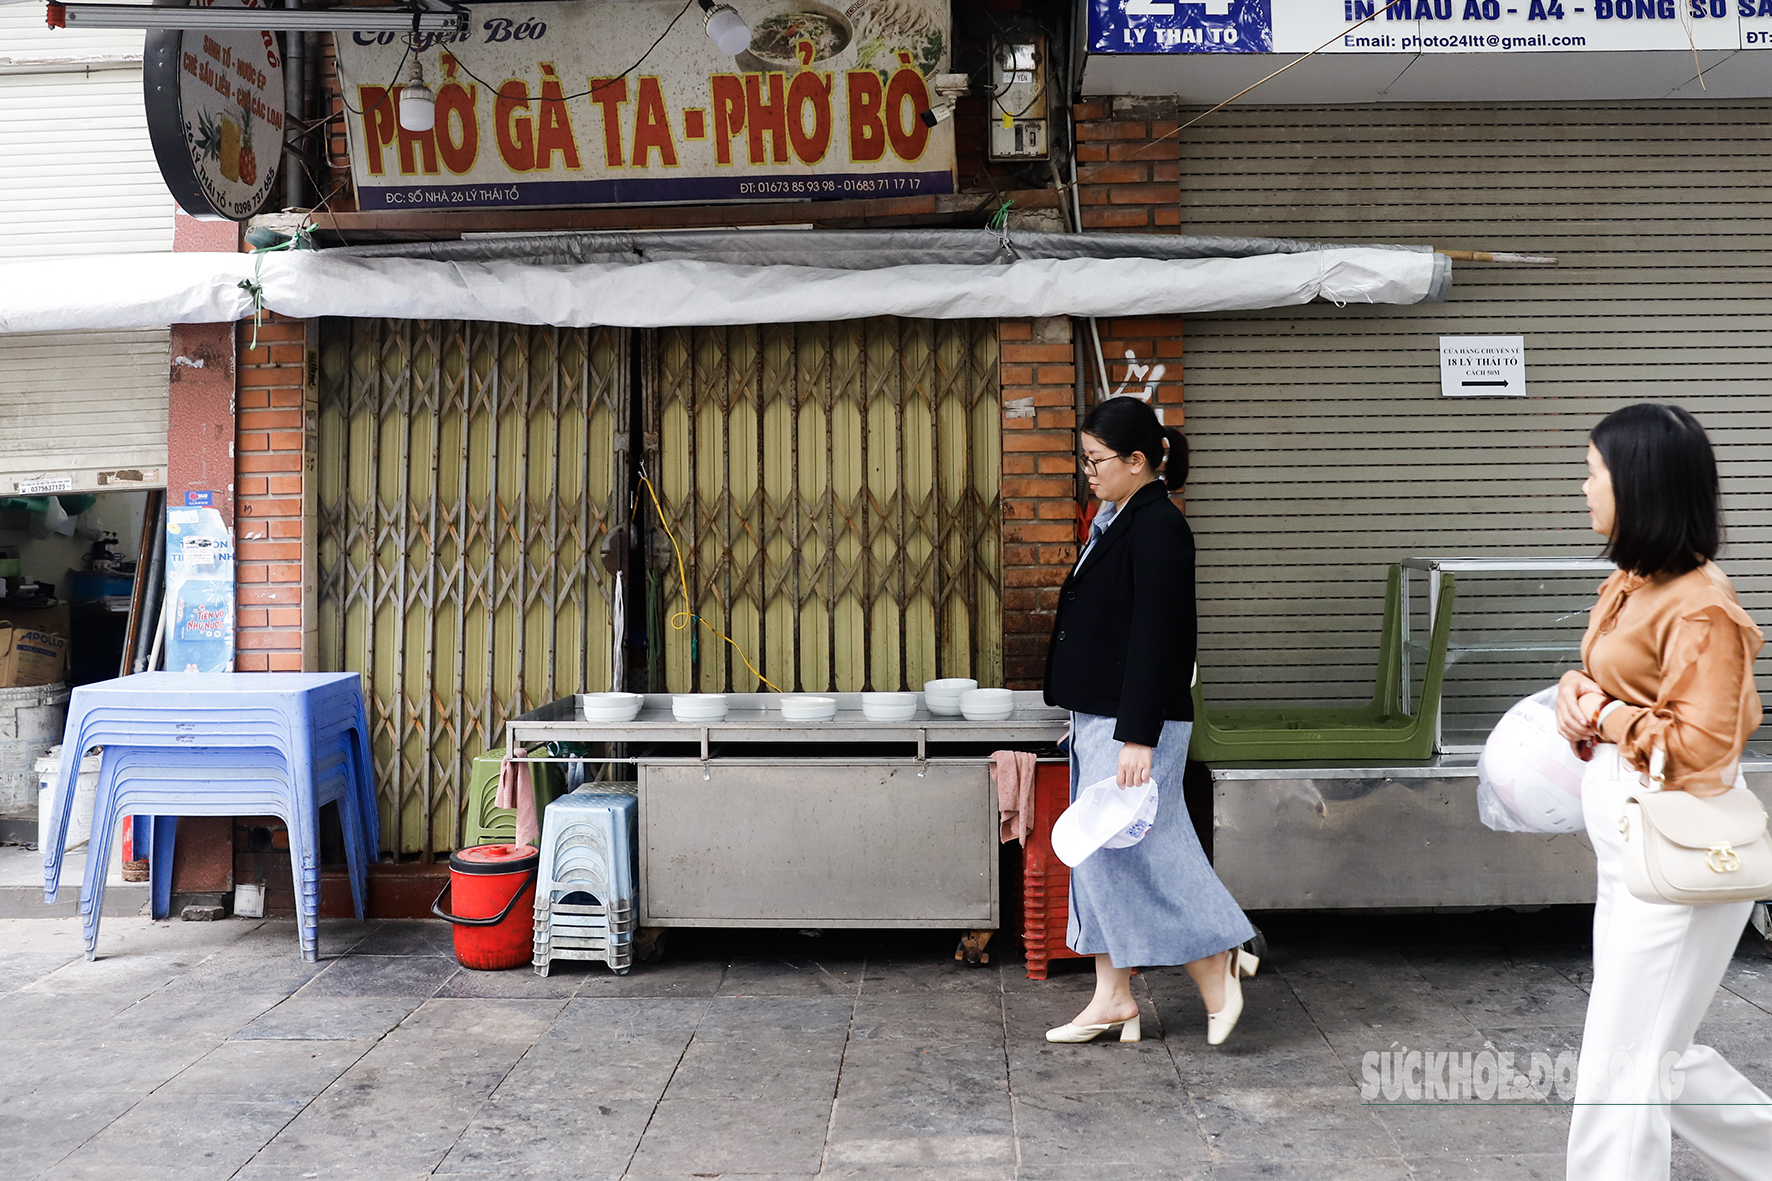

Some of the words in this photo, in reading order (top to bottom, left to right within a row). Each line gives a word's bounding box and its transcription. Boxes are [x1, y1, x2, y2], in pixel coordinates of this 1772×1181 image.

[1528, 0, 1565, 20] A4
[483, 17, 547, 44] Béo
[1123, 28, 1147, 43] LÝ
[1153, 27, 1203, 43] THÁI
[1210, 22, 1238, 44] TỔ
[1344, 35, 1396, 47] Email:
[1401, 34, 1586, 50] photo24ltt@gmail.com
[203, 34, 221, 62] SINH
[222, 46, 232, 68] TỐ
[237, 58, 256, 85] NƯỚC
[257, 69, 267, 91] ÉP
[183, 51, 198, 77] CHÈ
[251, 97, 266, 120] CÁC
[267, 106, 283, 131] LOẠI
[357, 51, 480, 176] PHỞ
[493, 61, 583, 174] GÀ
[588, 74, 680, 170] TA
[709, 38, 835, 167] PHỞ
[845, 49, 932, 165] BÒ
[185, 121, 195, 143] 26
[192, 146, 201, 164] LÝ
[199, 165, 216, 198] THÁI
[216, 190, 227, 208] TỔ
[234, 201, 252, 214] 0398
[252, 188, 264, 207] 737
[264, 167, 275, 191] 655
[385, 193, 406, 204] ĐC:
[408, 189, 424, 203] SỐ
[425, 190, 450, 203] NHÀ
[451, 191, 464, 202] 26
[466, 190, 478, 202] LÝ
[479, 188, 503, 201] THÁI
[504, 185, 520, 201] TỔ
[740, 183, 756, 194] ĐT:
[758, 181, 790, 193] 01673
[791, 181, 805, 192] 85
[806, 181, 820, 192] 93
[821, 181, 836, 192] 98
[843, 180, 876, 192] 01683
[877, 179, 889, 191] 71
[893, 179, 905, 191] 17
[909, 178, 921, 190] 17
[1447, 358, 1457, 366] 18
[1460, 356, 1473, 366] LÝ
[1475, 356, 1501, 366] THÁI
[20, 631, 64, 648] APOLLO
